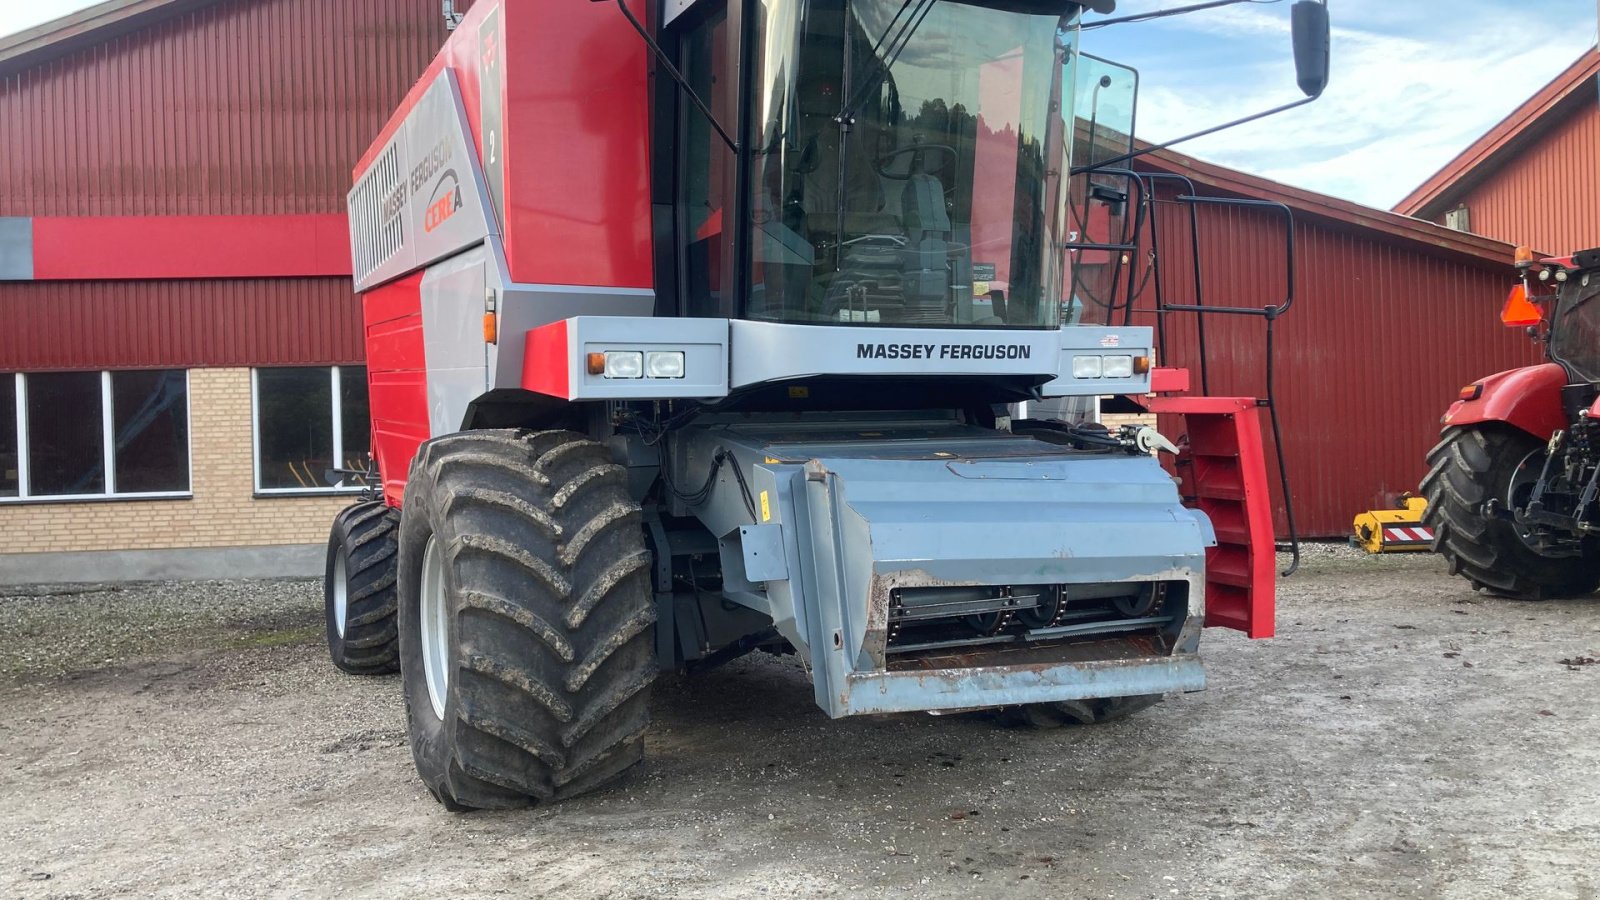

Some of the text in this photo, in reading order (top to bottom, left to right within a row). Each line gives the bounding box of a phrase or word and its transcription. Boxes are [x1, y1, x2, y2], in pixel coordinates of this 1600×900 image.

[489, 129, 496, 165] 2
[383, 136, 454, 225] MASSEY FERGUSON
[424, 184, 463, 233] CEREA
[856, 344, 1031, 359] MASSEY FERGUSON
